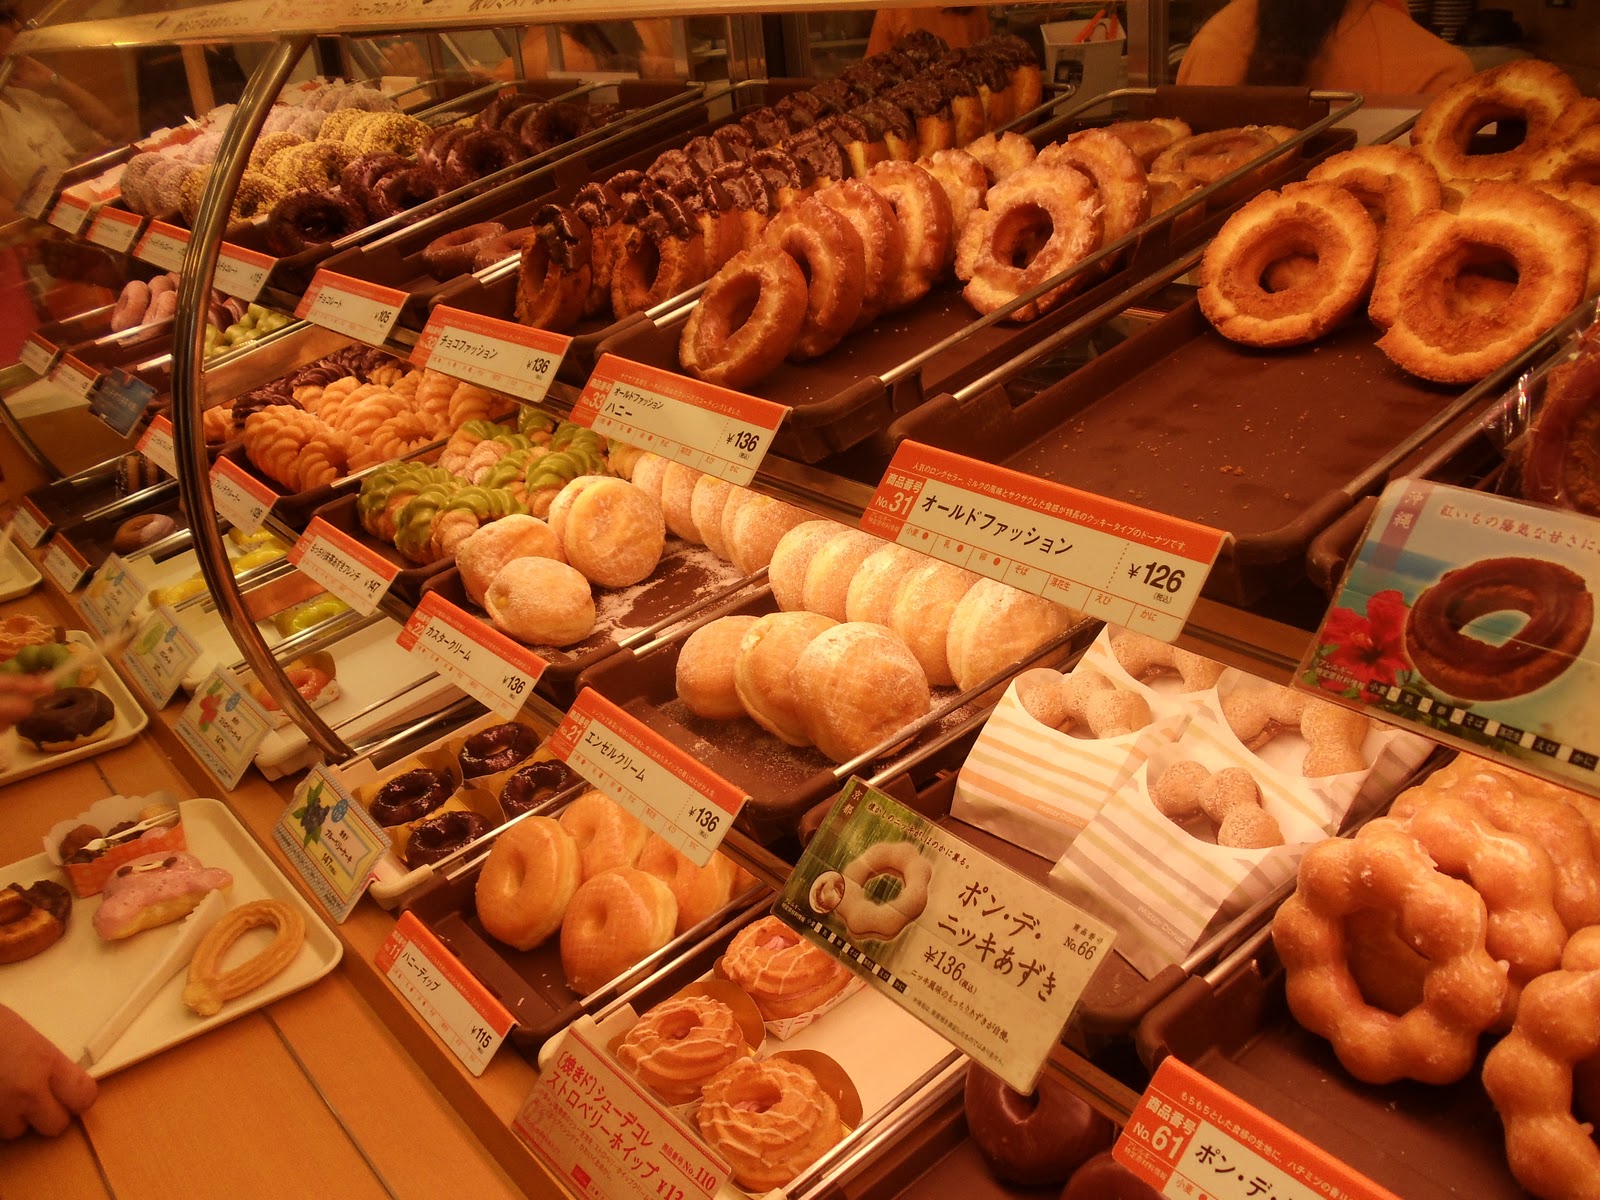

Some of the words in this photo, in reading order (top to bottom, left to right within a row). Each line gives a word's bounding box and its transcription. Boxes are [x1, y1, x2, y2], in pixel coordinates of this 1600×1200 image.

[439, 335, 498, 359] チョコファッション
[527, 358, 551, 374] ¥136
[614, 387, 664, 410] オールドファッション
[604, 402, 633, 417] ハニー
[727, 431, 760, 452] ¥136
[875, 491, 914, 515] No.31
[884, 472, 924, 494] 商品番号
[1391, 489, 1424, 529] 沖縄
[1439, 504, 1600, 554] 紅いもの陽気な甘さに
[922, 495, 1073, 554] オールドファッション
[1128, 562, 1185, 593] ¥126
[904, 526, 919, 537] 小麦
[942, 539, 952, 549] 乳
[1012, 563, 1030, 577] そば
[1048, 576, 1072, 592] 落花生
[1093, 592, 1113, 607] えび
[1138, 608, 1159, 623] かに
[1151, 591, 1173, 605] (税込)
[503, 675, 526, 694] ¥136
[584, 731, 645, 782] エンゼルクリーム
[689, 807, 720, 832] ¥136
[843, 789, 863, 815] 京都
[958, 881, 1041, 940] ポン・デ・
[1063, 936, 1097, 960] No.66
[1072, 923, 1103, 942] 商品番号
[938, 915, 1056, 1002] ニッキあずき
[402, 952, 441, 991] ハニーディップ
[471, 1026, 492, 1048] ¥115
[911, 970, 1008, 1043] ニッキ風味のもっちりあずきが自慢。
[543, 1070, 660, 1178] ストロベリーホイップ
[1145, 1094, 1197, 1136] 商品番号
[682, 1161, 716, 1191] No.110
[1132, 1122, 1185, 1161] No.61
[1194, 1143, 1293, 1200] ポン・デ・
